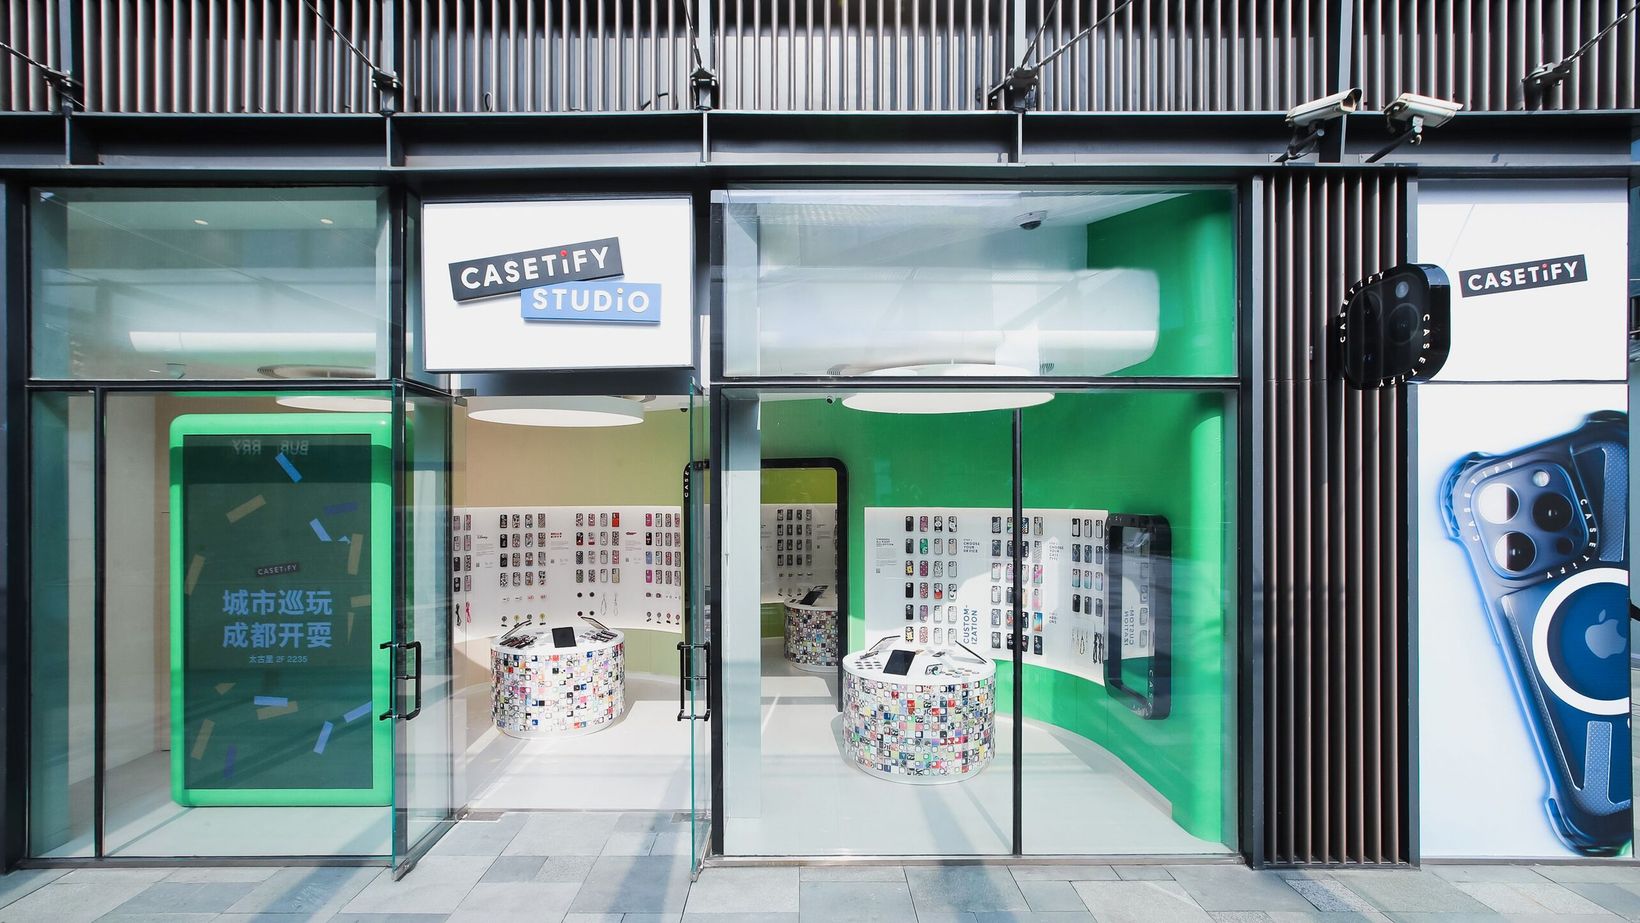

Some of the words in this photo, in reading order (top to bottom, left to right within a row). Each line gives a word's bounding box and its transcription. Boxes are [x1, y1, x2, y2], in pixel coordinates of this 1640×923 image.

[461, 246, 609, 290] CASETiFY
[1467, 260, 1578, 291] CASETiFY
[532, 288, 650, 313] STUDiO
[222, 589, 332, 615] 城市巡玩
[222, 621, 332, 648] 成都开耍
[287, 655, 308, 663] 2235
